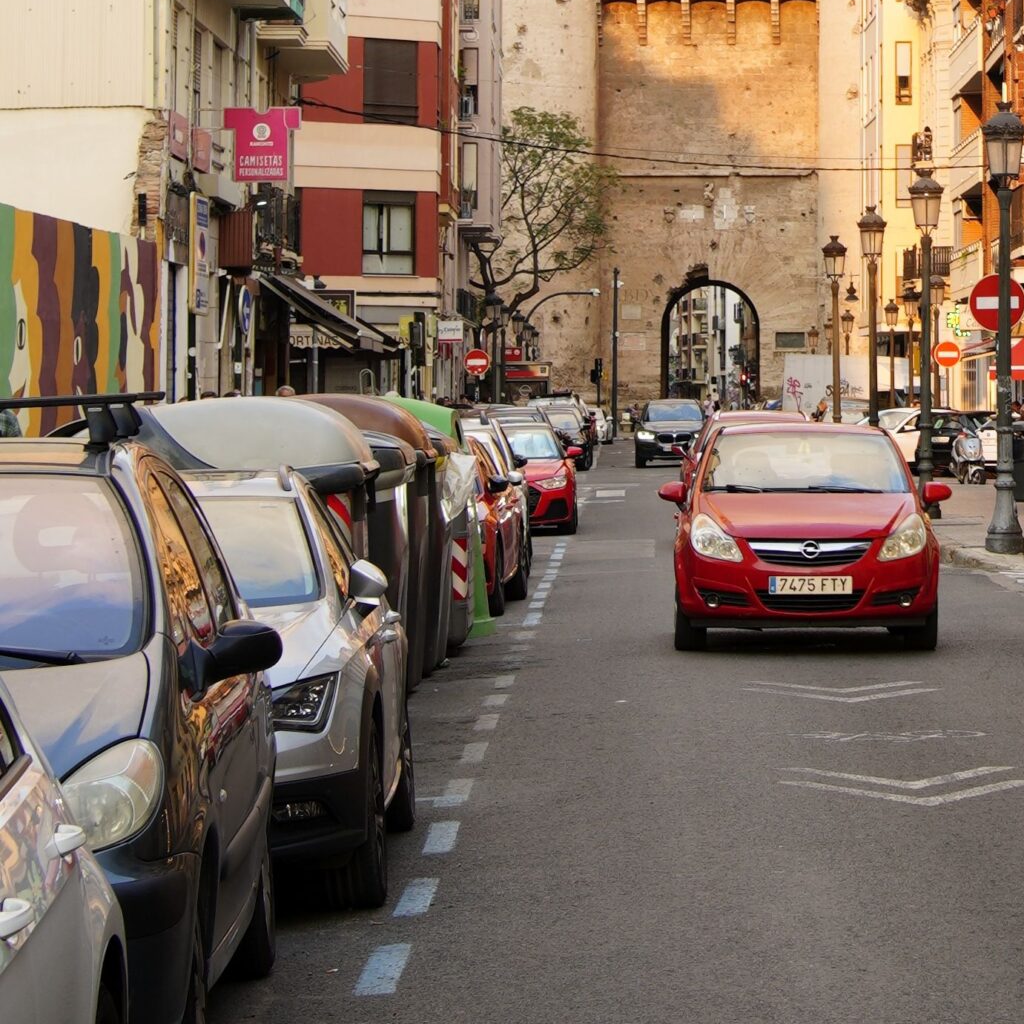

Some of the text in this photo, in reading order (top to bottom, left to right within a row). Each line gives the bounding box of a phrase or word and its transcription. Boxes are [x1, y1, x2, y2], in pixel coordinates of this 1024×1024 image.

[239, 155, 283, 167] CAMISETAS
[239, 167, 284, 176] PERSONALIZADAS
[289, 335, 341, 346] ORTNAS
[779, 578, 847, 592] 7475 FTY
